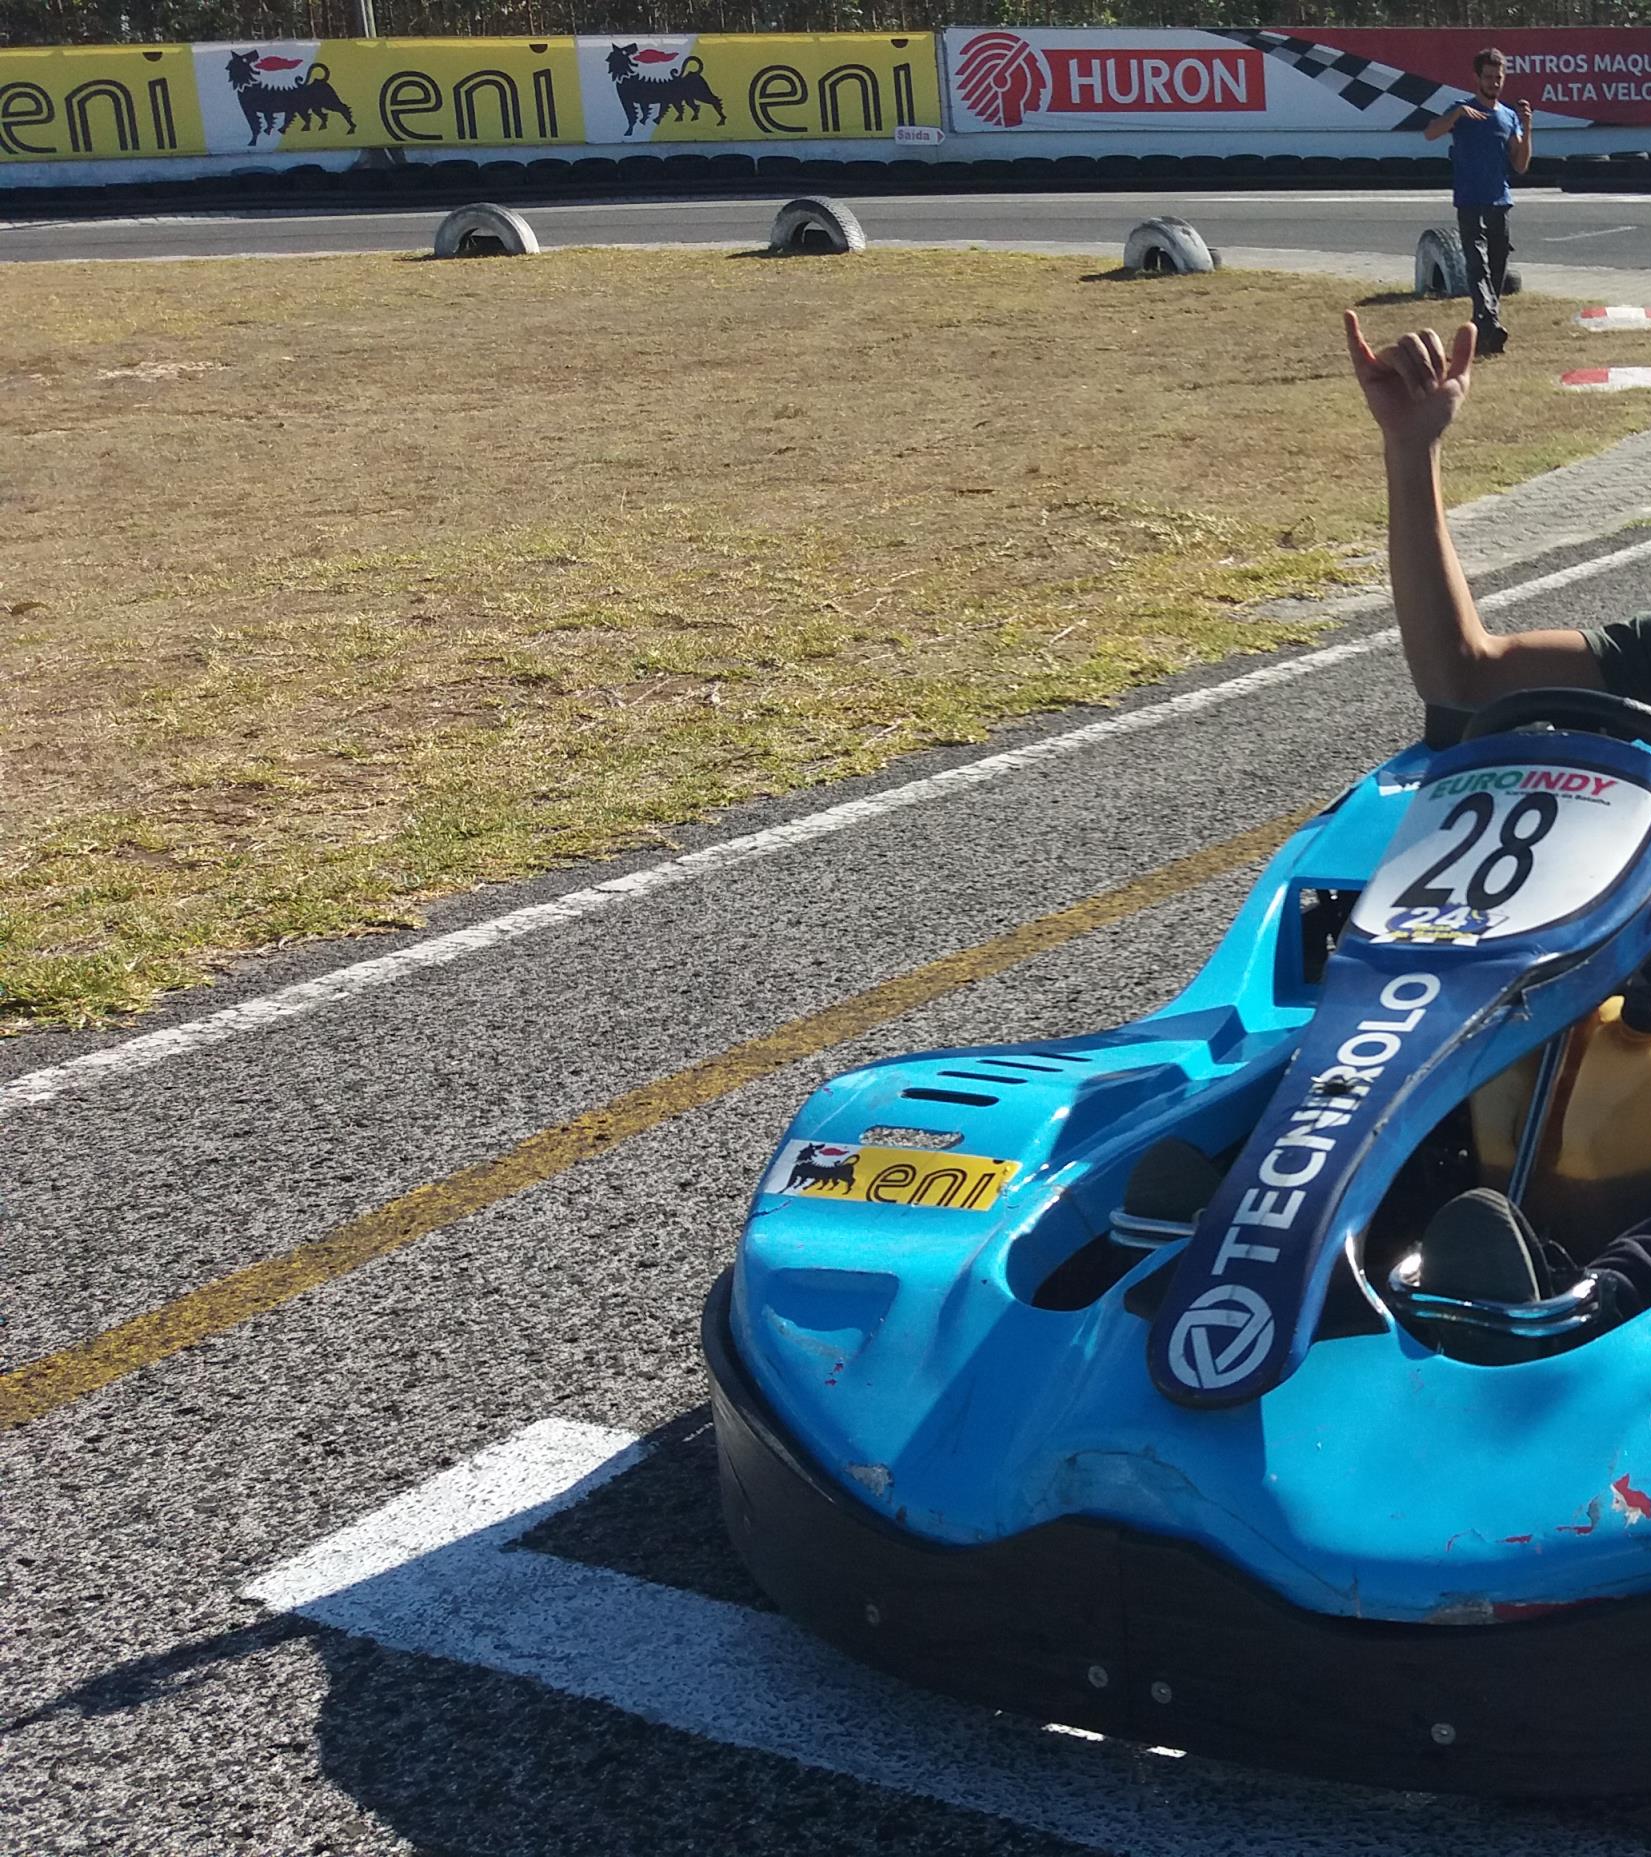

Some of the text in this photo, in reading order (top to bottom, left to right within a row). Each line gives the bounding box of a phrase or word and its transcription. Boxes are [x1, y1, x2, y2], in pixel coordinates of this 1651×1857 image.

[749, 39, 916, 133] eni
[1068, 58, 1248, 104] HURON
[1504, 53, 1588, 74] ENTROS
[0, 51, 177, 154] eni
[379, 44, 558, 141] eni
[1542, 82, 1597, 102] ALTA
[1428, 769, 1618, 801] EUROINDY
[1391, 790, 1559, 911] 28
[1398, 905, 1474, 931] 24
[866, 1158, 1003, 1210] eni
